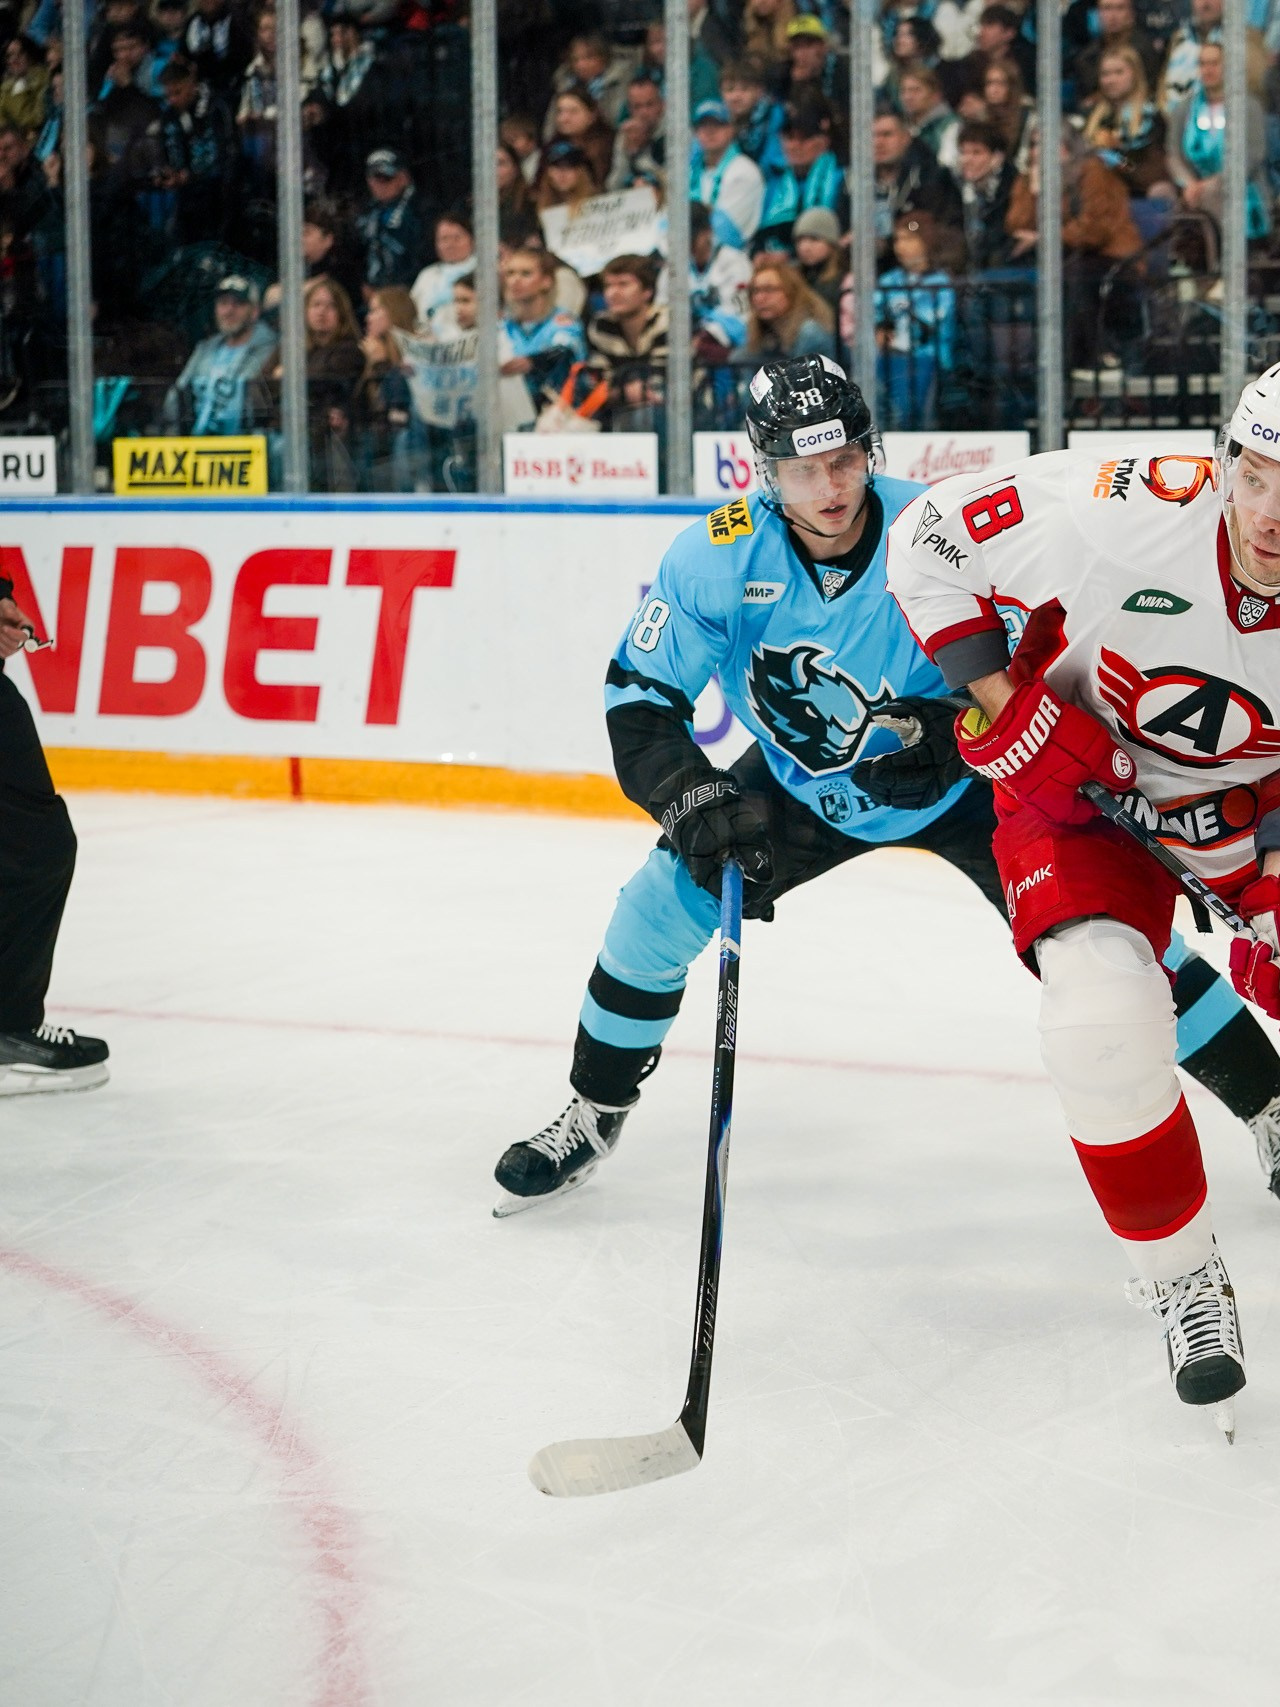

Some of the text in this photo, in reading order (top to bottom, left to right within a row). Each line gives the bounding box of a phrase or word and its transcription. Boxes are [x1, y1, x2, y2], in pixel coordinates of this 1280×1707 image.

[792, 387, 824, 410] 38
[796, 428, 843, 448] согаз
[3, 454, 45, 480] RU
[128, 450, 188, 477] MAX
[192, 460, 251, 488] LINE
[512, 458, 648, 479] BSB Bank
[961, 476, 1024, 545] 8
[1136, 594, 1174, 609] МИР
[626, 593, 671, 653] 8
[1140, 682, 1235, 757] A
[968, 693, 1062, 780] ARRIOR
[660, 780, 740, 840] AUER
